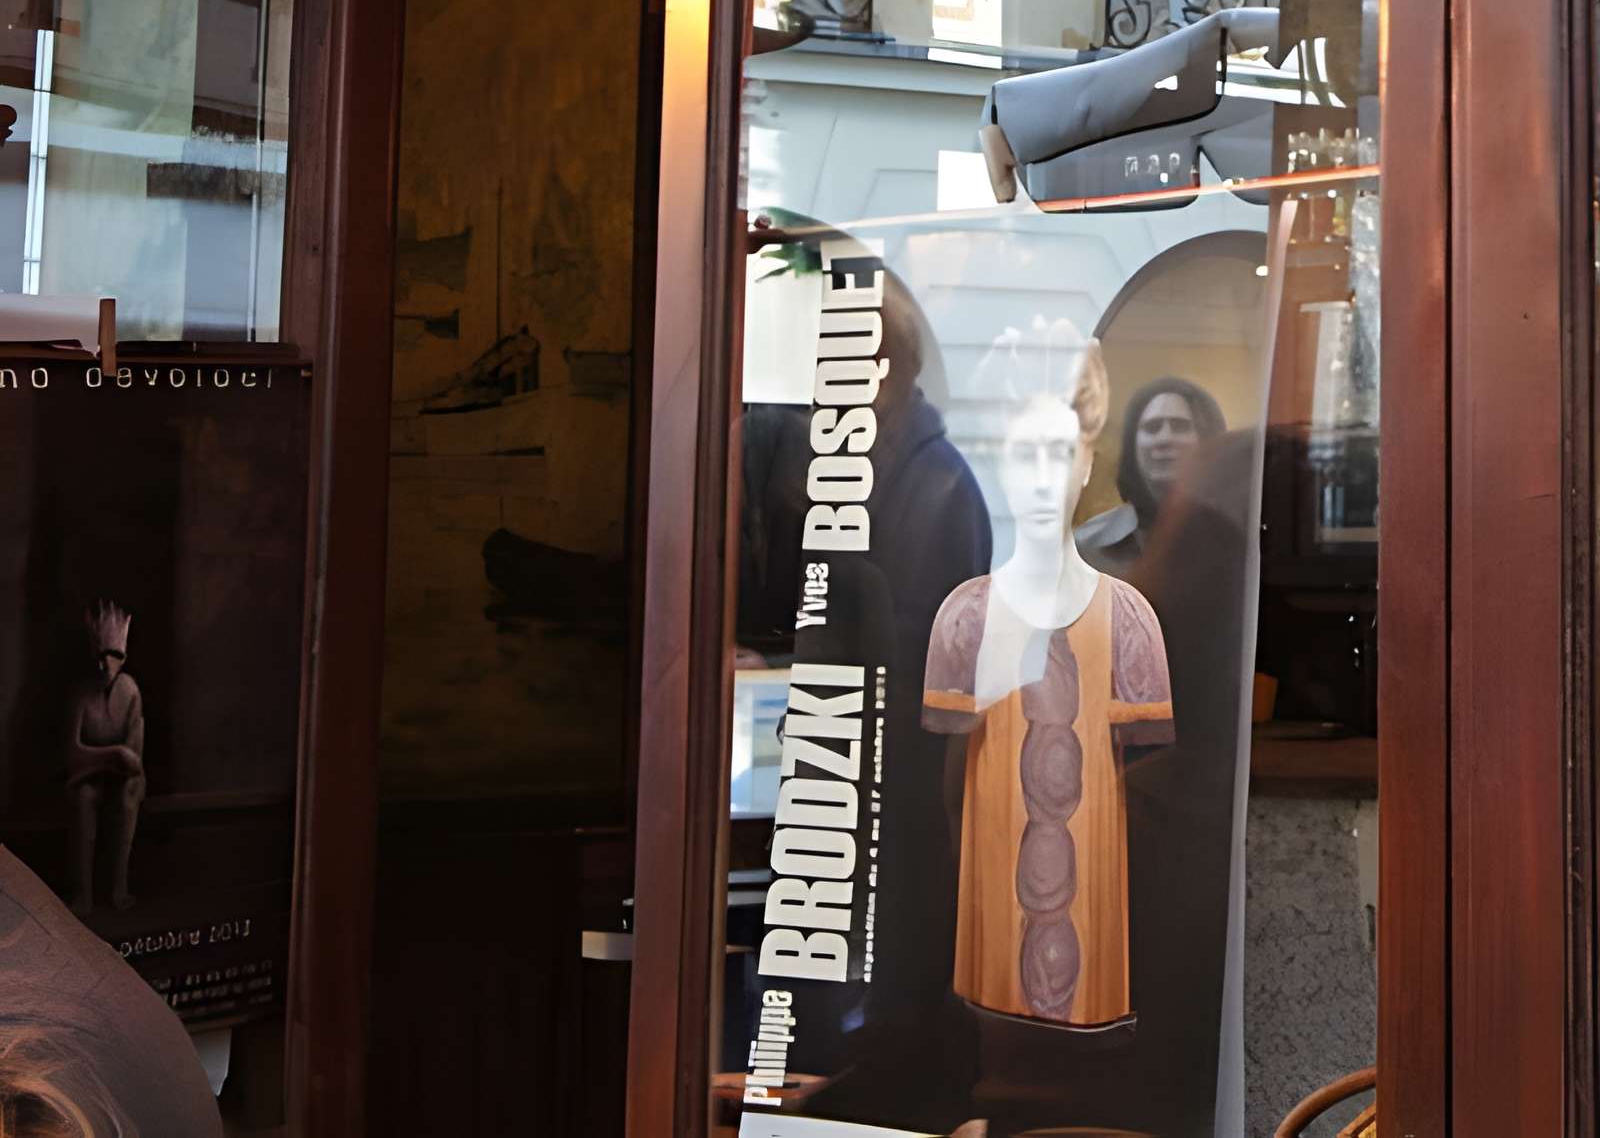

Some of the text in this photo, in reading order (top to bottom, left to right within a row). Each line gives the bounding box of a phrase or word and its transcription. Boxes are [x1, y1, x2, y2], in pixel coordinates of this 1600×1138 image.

[795, 238, 890, 630] Yves BOSQUET
[743, 663, 865, 1106] Philippe BRODZKI
